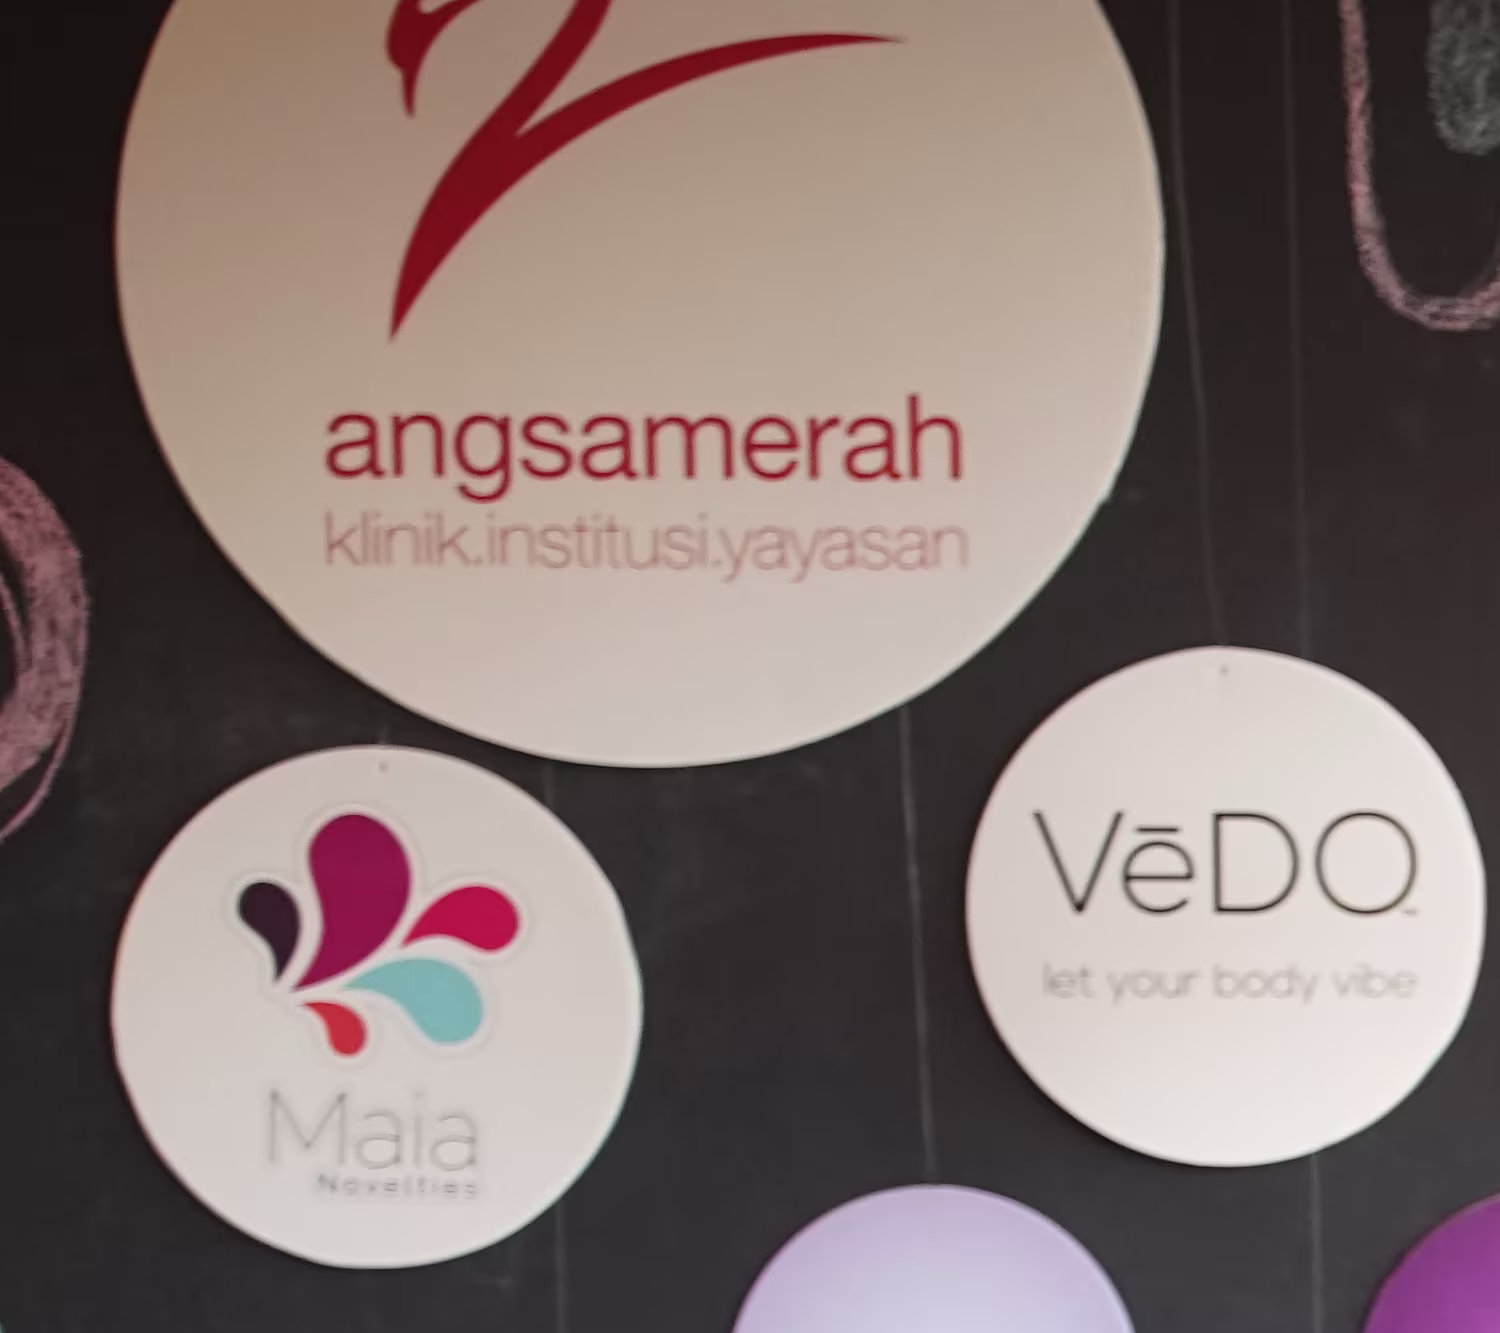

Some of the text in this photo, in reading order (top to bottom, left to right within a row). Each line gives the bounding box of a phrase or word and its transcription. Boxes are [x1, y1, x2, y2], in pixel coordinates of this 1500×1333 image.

[325, 391, 963, 505] angsamerah
[324, 511, 970, 585] klinik.institusi.yayasan
[1041, 962, 1419, 1006] let your body vibe
[265, 1088, 478, 1172] Maia
